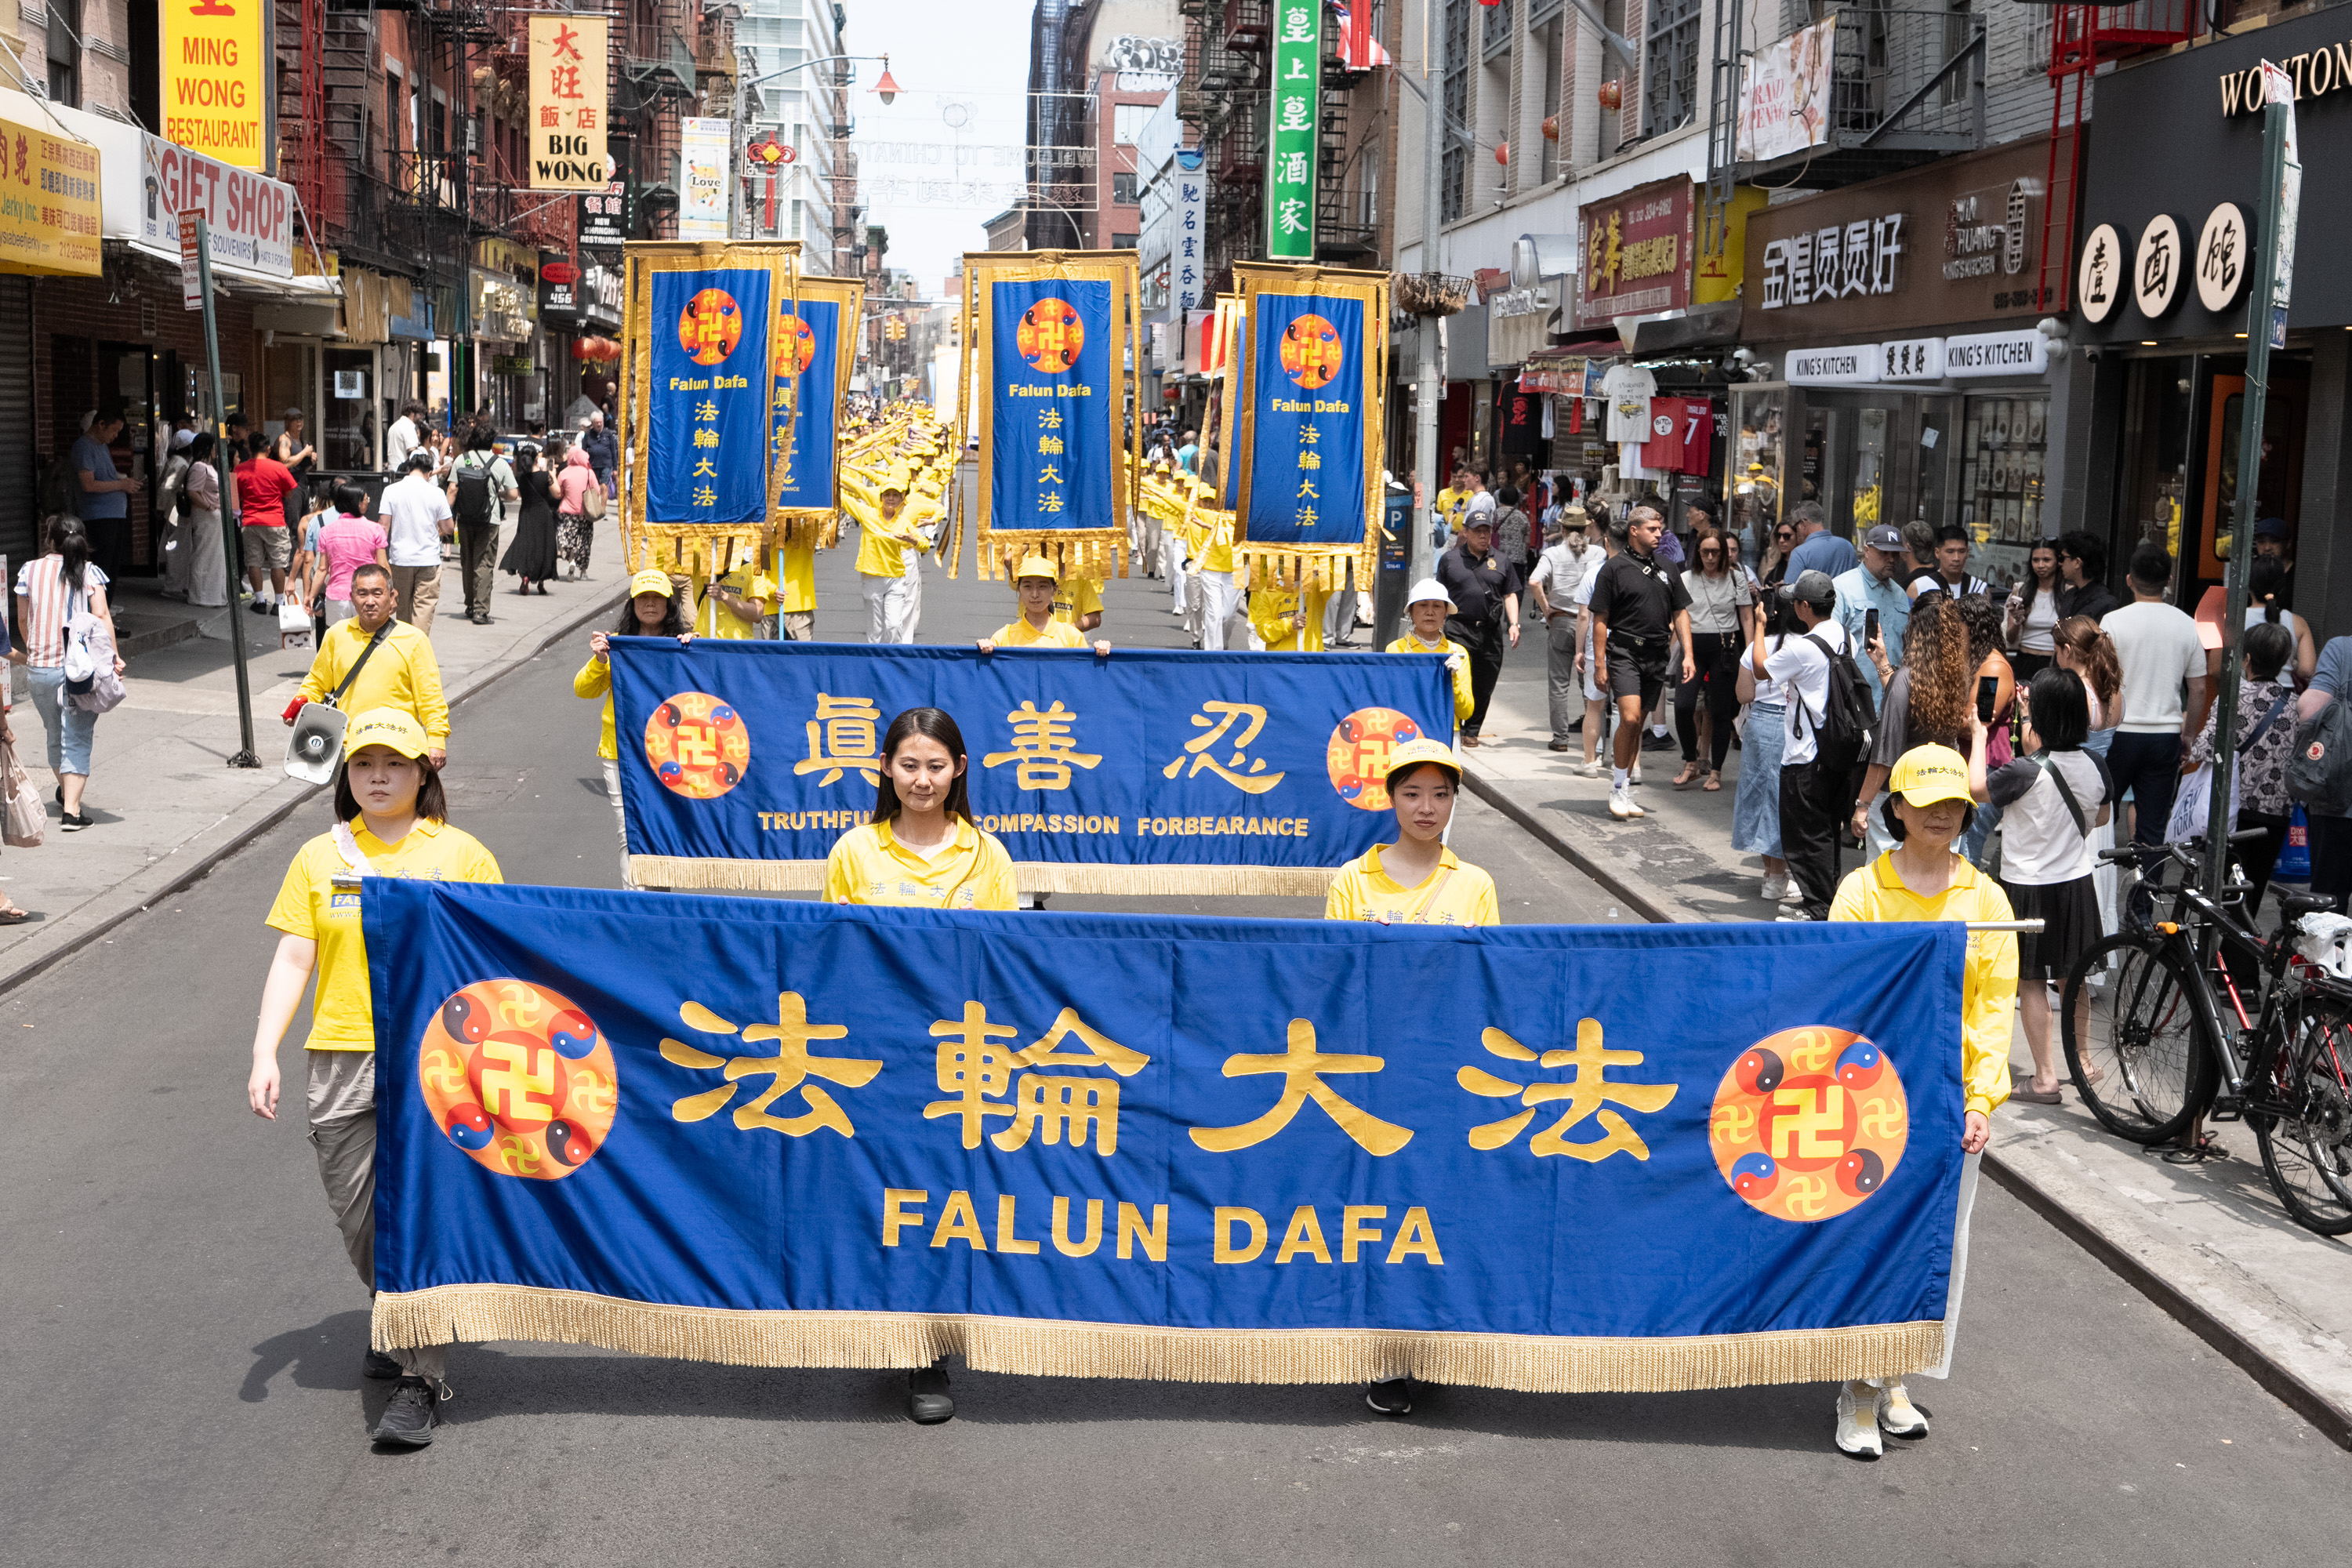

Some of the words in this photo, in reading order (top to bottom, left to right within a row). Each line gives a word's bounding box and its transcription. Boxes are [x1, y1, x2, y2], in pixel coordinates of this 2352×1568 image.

[183, 36, 238, 67] MING
[551, 23, 584, 100] 大旺
[176, 77, 245, 108] WONG
[539, 105, 597, 130] 飯店
[167, 117, 258, 149] RESTAURANT
[549, 134, 588, 156] BIG
[535, 160, 602, 183] WONG
[691, 176, 721, 187] Love
[2, 192, 24, 224] Jerky
[25, 197, 40, 223] Inc.
[161, 148, 220, 226] GIFT
[226, 171, 285, 243] SHOP
[165, 221, 180, 241] ALL
[594, 217, 610, 226] NEW
[212, 234, 251, 260] SOUVENIRS
[550, 292, 572, 303] 456
[1796, 356, 1820, 376] KING'S
[1823, 355, 1857, 376] KITCHEN
[1948, 343, 1983, 368] KING'S
[1984, 340, 2033, 365] KITCHEN
[670, 377, 709, 391] Falun
[713, 375, 748, 390] Dafa
[1009, 384, 1053, 397] Falun
[1057, 383, 1091, 397] Dafa
[1272, 399, 1312, 412] Falun
[1315, 399, 1350, 413] Dafa
[1684, 418, 1699, 445] 7
[692, 400, 720, 507] 法輪大法
[1038, 407, 1065, 513] 法輪大法
[1295, 423, 1322, 527] 法輪大法
[1391, 510, 1403, 528] P
[757, 810, 873, 831] TRUTHFU
[973, 813, 1120, 834] COMPASSION
[1138, 815, 1308, 837] FORBEARANCE
[2173, 808, 2194, 838] YORK
[332, 866, 442, 881] 法大法
[334, 895, 361, 906] FAL
[869, 882, 975, 902] 法輪大法
[659, 991, 1678, 1163] 法輪大法
[882, 1188, 1168, 1262] FALUN
[1213, 1204, 1444, 1265] DAFA
